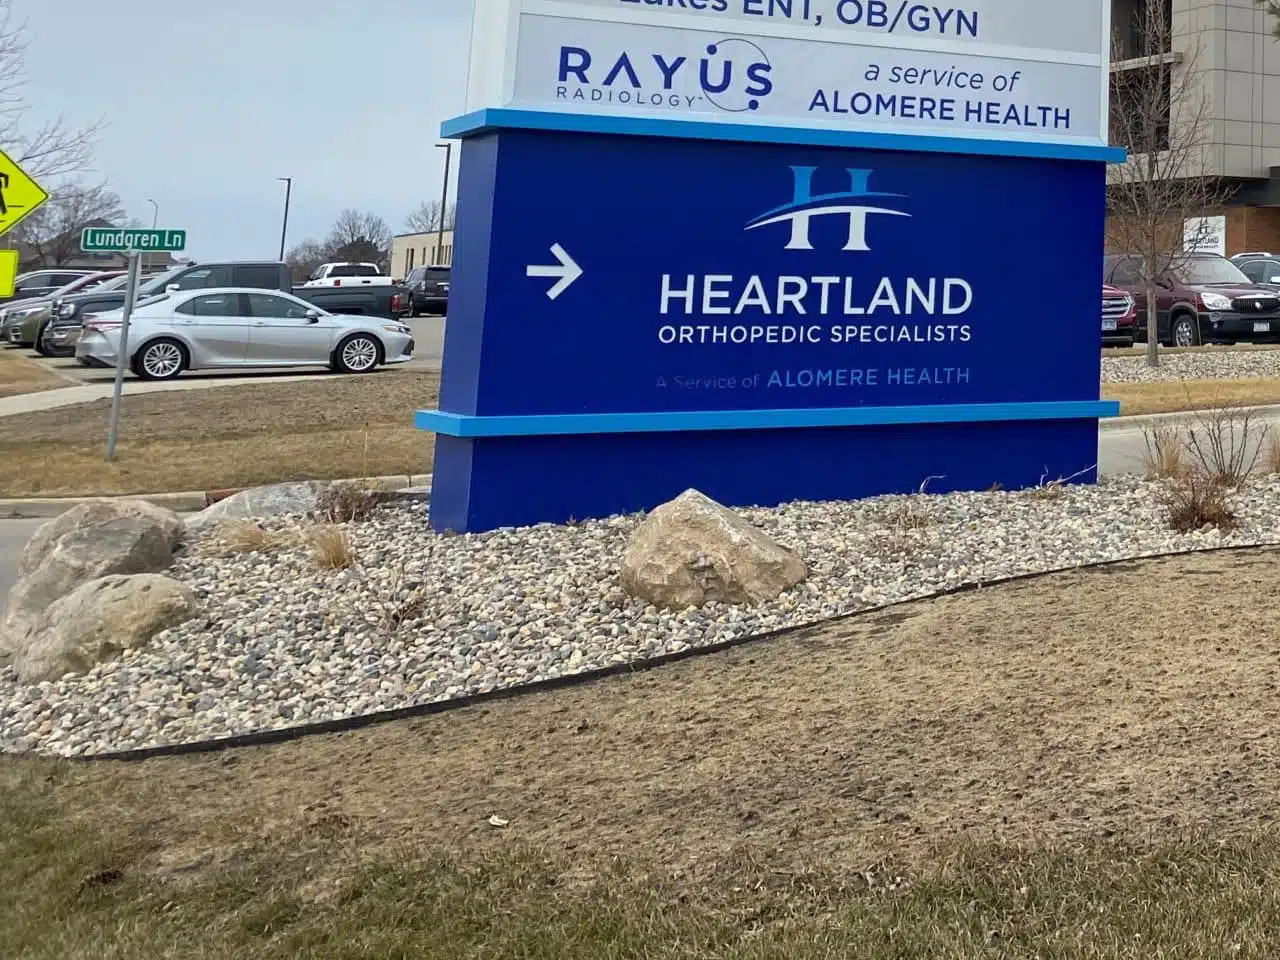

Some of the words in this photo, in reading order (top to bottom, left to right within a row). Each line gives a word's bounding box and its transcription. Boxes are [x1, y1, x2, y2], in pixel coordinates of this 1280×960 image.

[864, 64, 880, 81] a
[888, 65, 984, 90] service
[992, 71, 1021, 92] of
[556, 86, 696, 107] RADIOLOGY
[808, 89, 955, 120] ALOMERE
[965, 100, 1071, 129] HEALTH
[86, 229, 159, 250] Lundgren
[164, 230, 182, 247] Ln
[659, 274, 973, 315] HEARTLAND
[658, 326, 821, 344] ORTHOPEDIC
[830, 325, 972, 343] SPECIALISTS
[742, 372, 760, 389] of
[767, 368, 879, 388] ALOMERE
[887, 367, 970, 385] HEALTH
